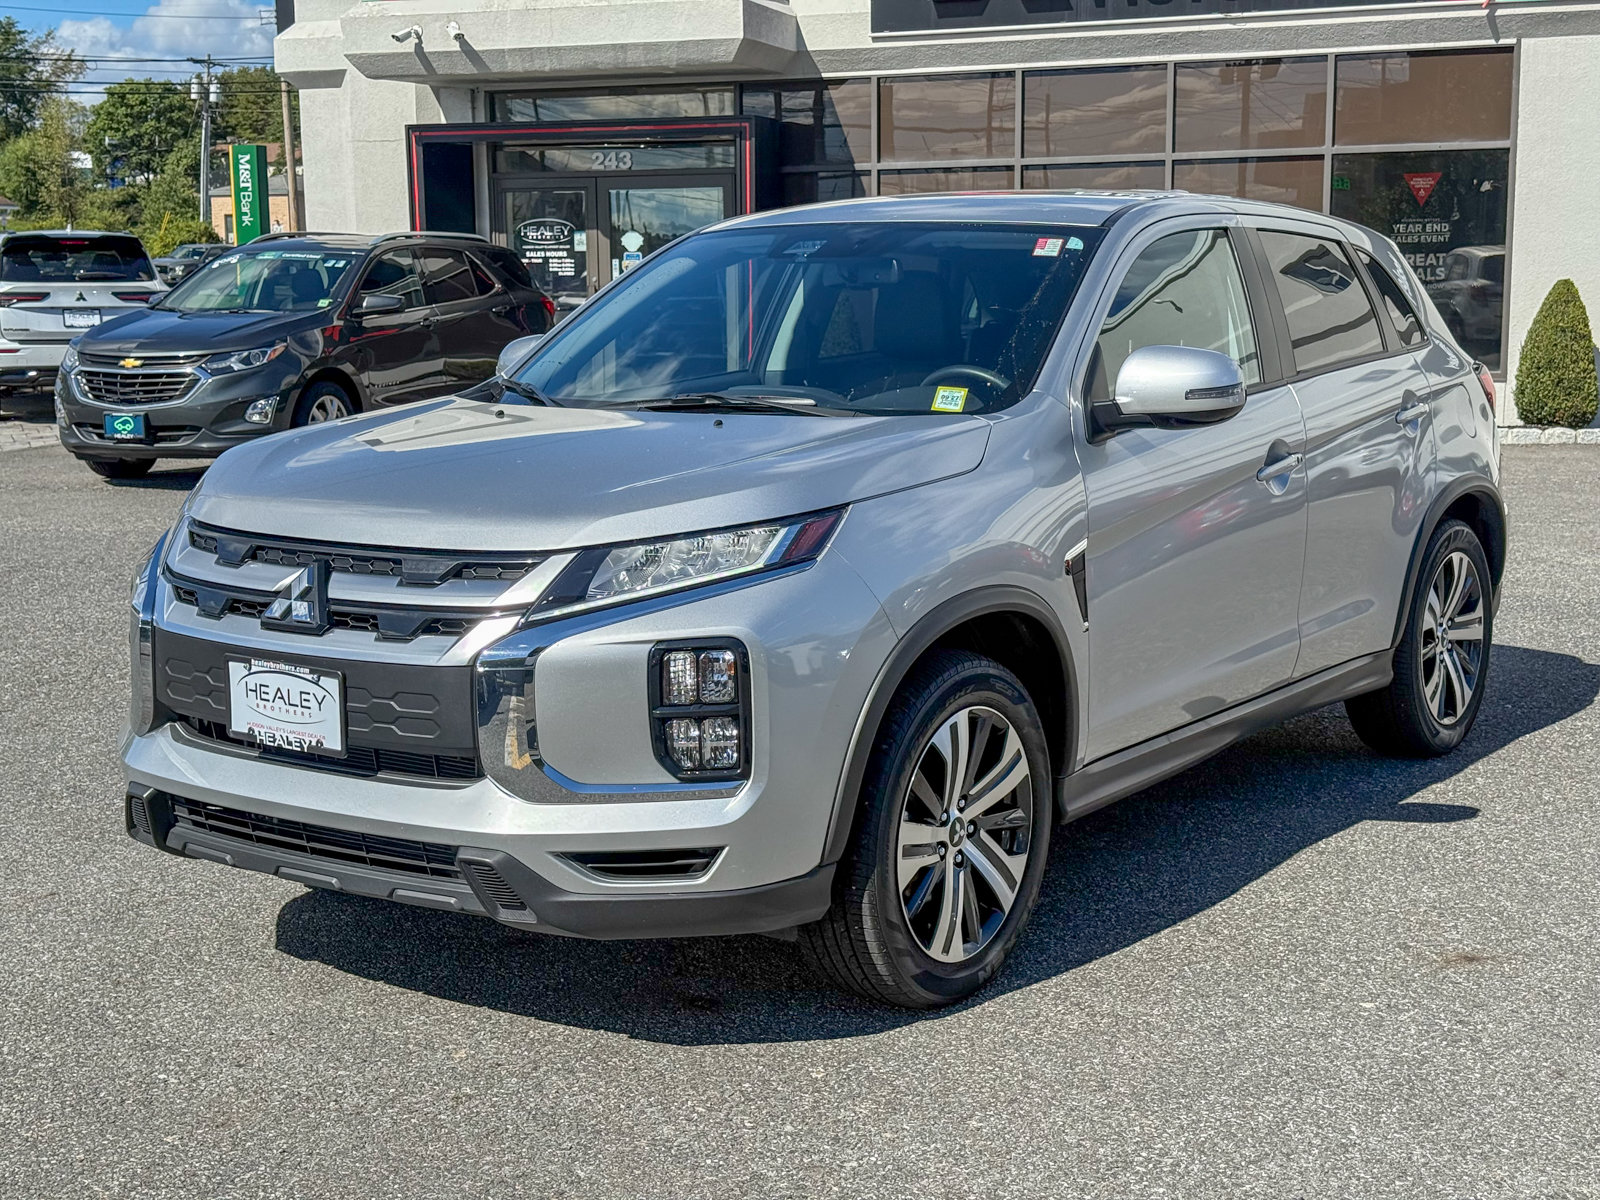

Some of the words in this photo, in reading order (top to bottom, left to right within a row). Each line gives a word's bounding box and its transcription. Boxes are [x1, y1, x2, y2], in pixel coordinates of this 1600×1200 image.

[591, 151, 632, 170] 243
[237, 153, 253, 191] M&T
[240, 191, 254, 227] Bank
[520, 225, 571, 236] HEALEY
[1392, 223, 1423, 234] YEAR
[1425, 223, 1450, 233] END
[1420, 234, 1450, 243] EVENT
[1405, 252, 1446, 267] REAT
[1417, 267, 1446, 281] ALS
[251, 658, 310, 674] healeybrothers.com
[245, 681, 327, 712] HEALEY
[255, 703, 312, 719] BROTHERS
[246, 721, 266, 730] HUDSON
[286, 729, 307, 738] LARGEST
[256, 730, 311, 753] HEALEY
